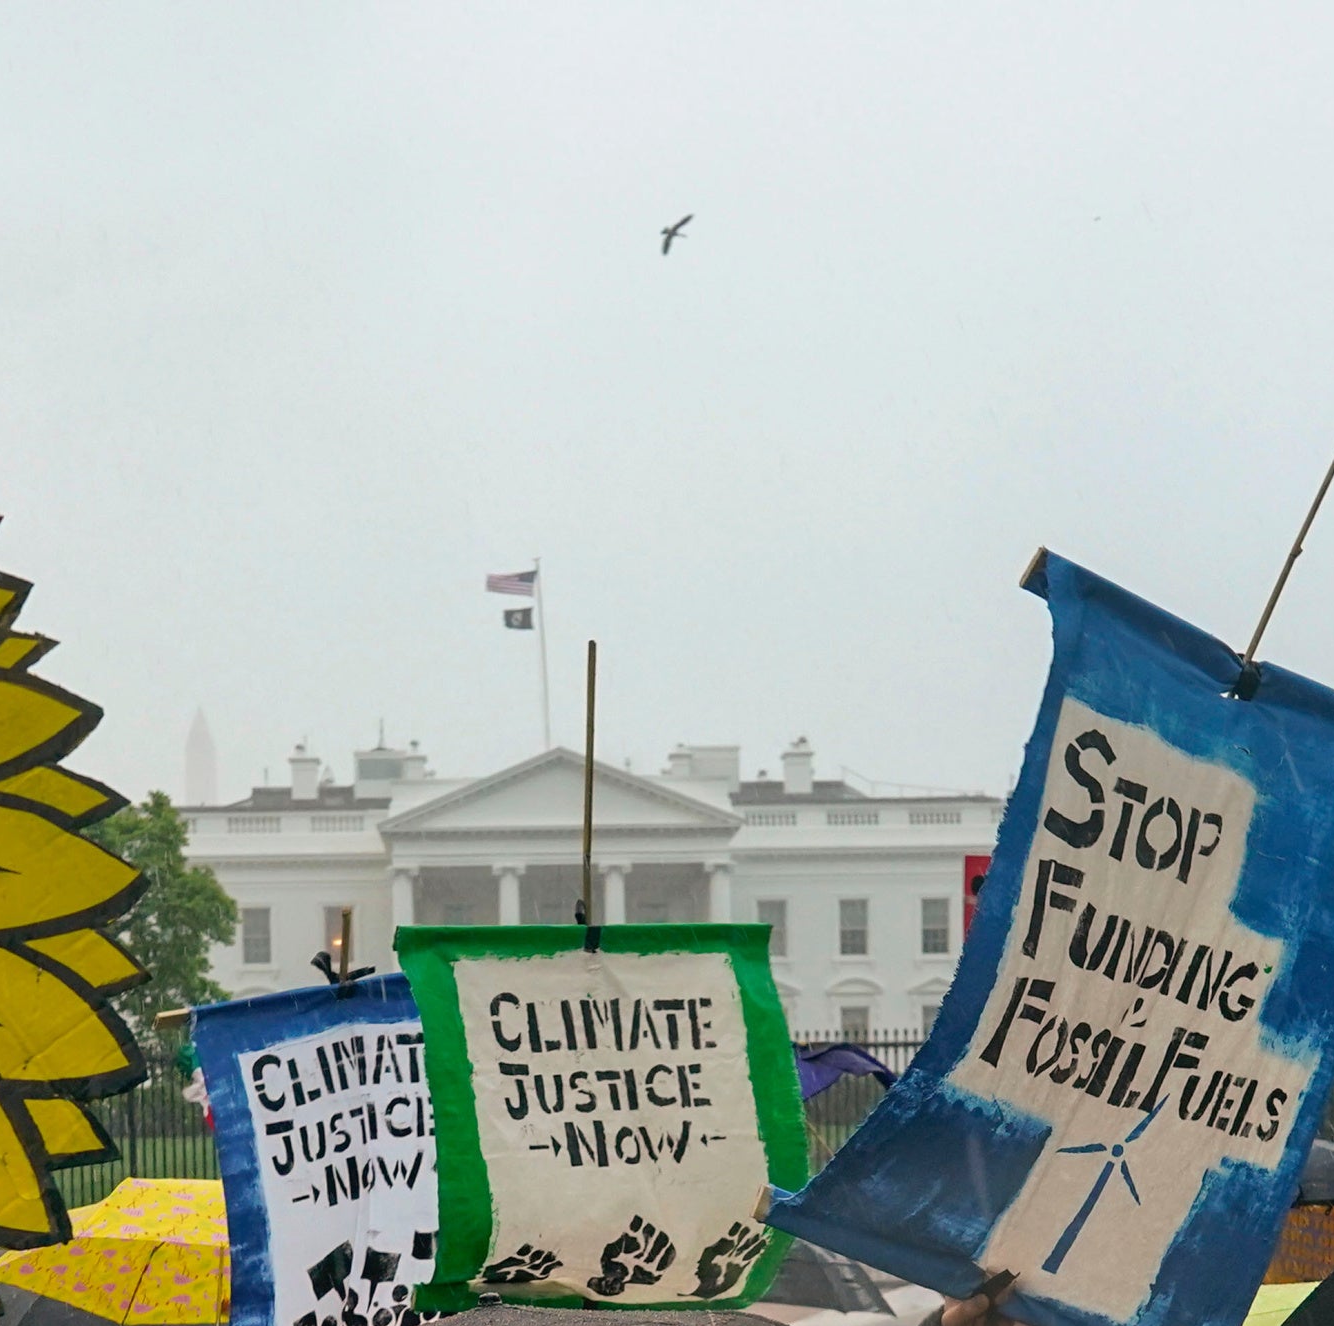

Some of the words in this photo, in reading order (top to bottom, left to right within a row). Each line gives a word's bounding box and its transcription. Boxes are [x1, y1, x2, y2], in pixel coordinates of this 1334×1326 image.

[1045, 729, 1222, 884] STOP
[1022, 858, 1258, 1022] FUNDING
[489, 991, 717, 1052] CLIMATE
[979, 976, 1143, 1109] FOSSIL
[1141, 1027, 1287, 1142] FUELS
[498, 1062, 711, 1120] JUSTICE
[566, 1119, 692, 1168] NOW
[324, 1150, 423, 1206] NOW
